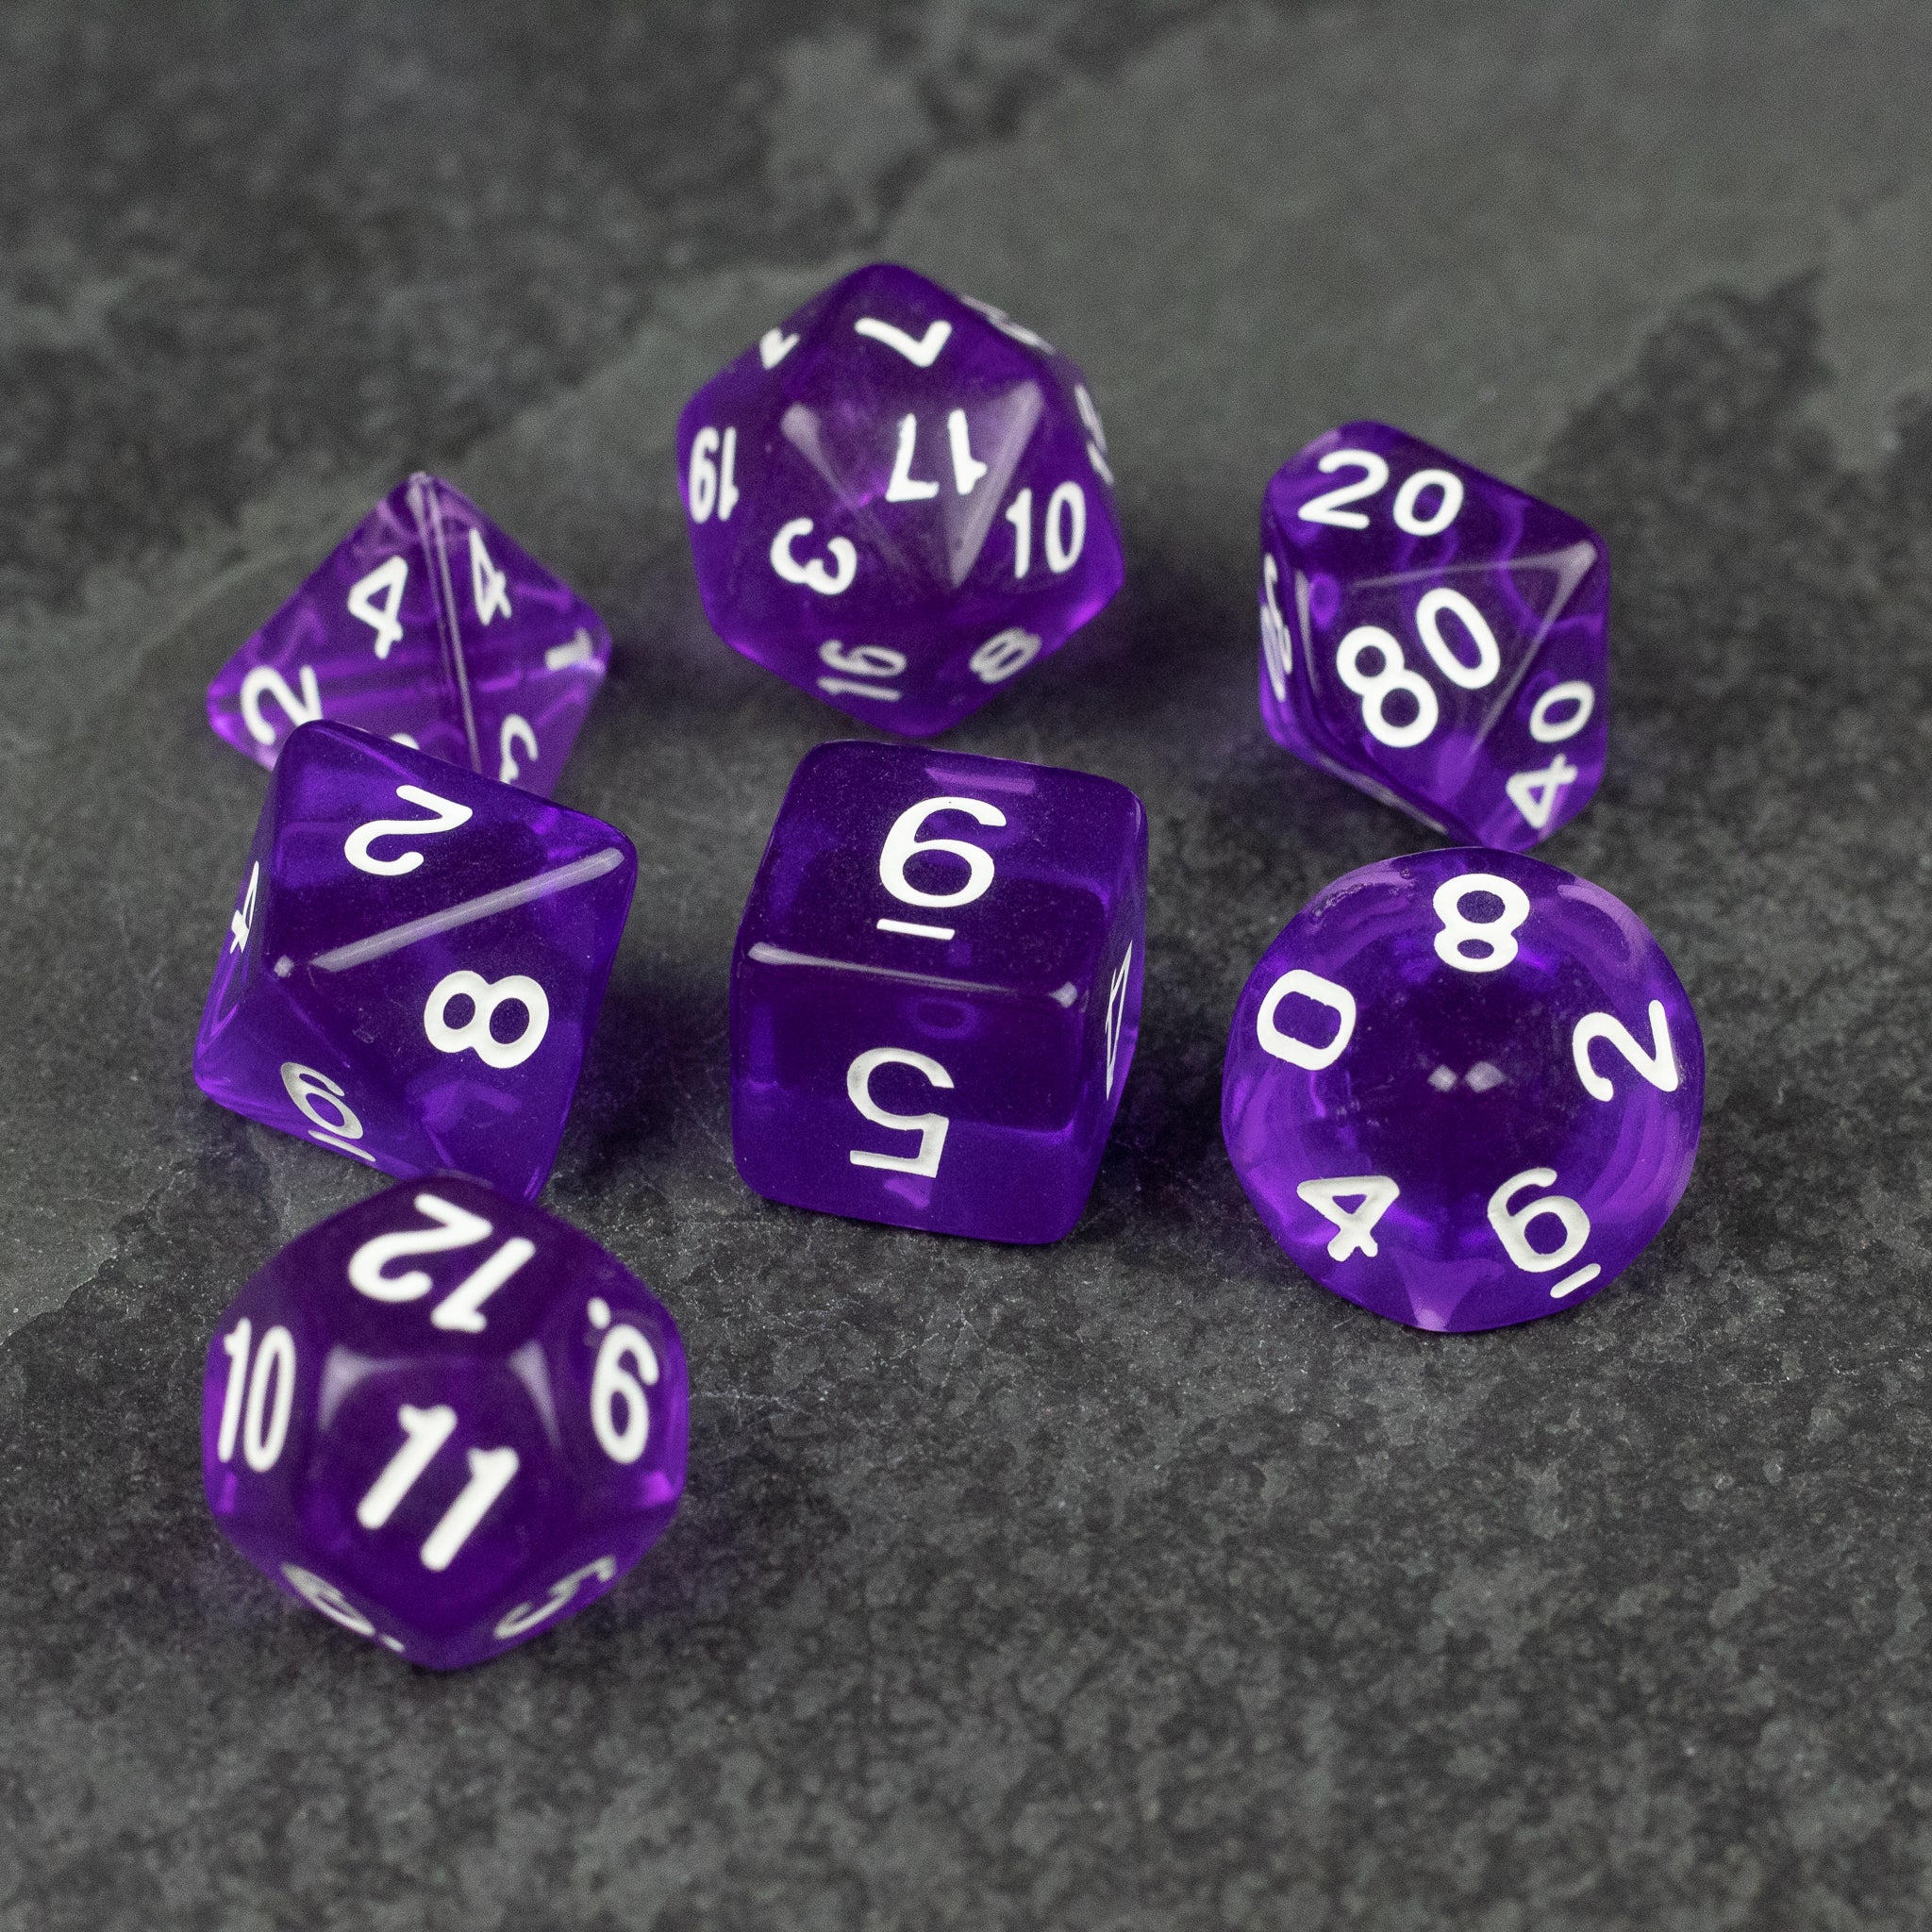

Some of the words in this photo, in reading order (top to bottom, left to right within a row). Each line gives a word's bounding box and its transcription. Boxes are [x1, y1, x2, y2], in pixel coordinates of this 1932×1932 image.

[854, 316, 954, 368] 7
[689, 425, 741, 525] 19
[884, 408, 988, 503] 17
[1297, 447, 1465, 538] 20
[467, 526, 513, 626] 4
[769, 516, 858, 596] 3
[1005, 480, 1088, 579] 10
[346, 555, 409, 660] 4
[968, 626, 1042, 683] 8
[239, 664, 324, 746] 2
[817, 639, 908, 702] 16
[1335, 586, 1502, 750] 80
[1505, 680, 1595, 830] 40
[342, 783, 475, 877] 2
[877, 795, 1008, 941] 6
[1431, 872, 1532, 974] 8
[423, 969, 551, 1071] 8
[1256, 968, 1357, 1072] 0
[1571, 998, 1684, 1104] 2
[845, 1046, 956, 1179] 5
[347, 1192, 536, 1334] 12
[1295, 1174, 1402, 1263] 4
[1486, 1166, 1603, 1300] 6
[217, 1317, 297, 1474] 10
[356, 1403, 520, 1572] 11
